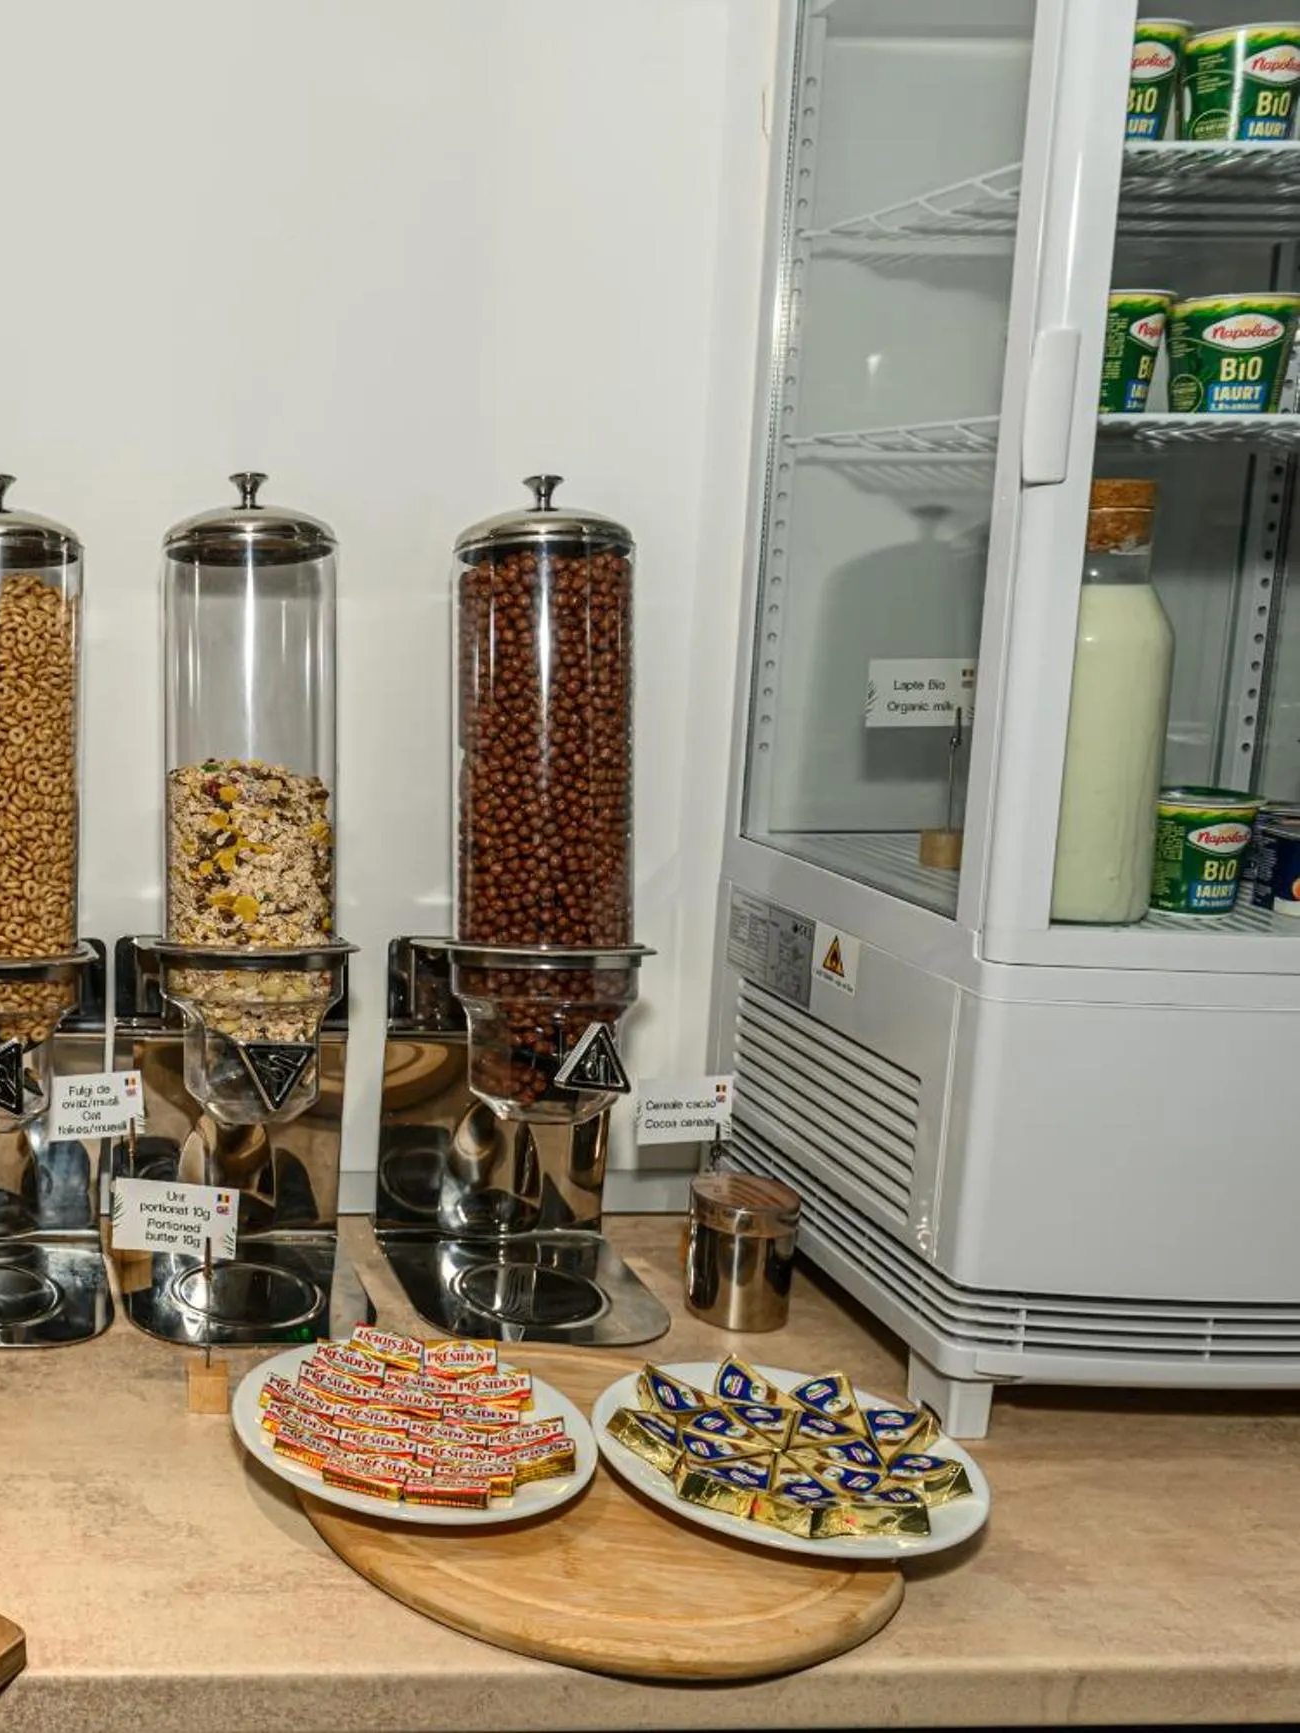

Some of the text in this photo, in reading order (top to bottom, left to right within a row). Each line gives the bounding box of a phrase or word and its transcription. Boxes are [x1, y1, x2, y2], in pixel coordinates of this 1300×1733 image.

[1252, 56, 1300, 72] Napola
[1212, 323, 1279, 340] Napolact
[1212, 386, 1263, 401] IAURT
[893, 680, 925, 692] Lapte
[887, 701, 929, 714] Organic
[1196, 884, 1235, 898] IAURT
[69, 1085, 111, 1098] Fulgi de
[645, 1100, 716, 1110] Cereale cacao
[82, 1110, 102, 1121] Oat
[645, 1119, 677, 1129] Cocoa
[193, 1206, 211, 1221] 10g
[147, 1217, 201, 1234] Portioned
[145, 1231, 200, 1249] butter 10g
